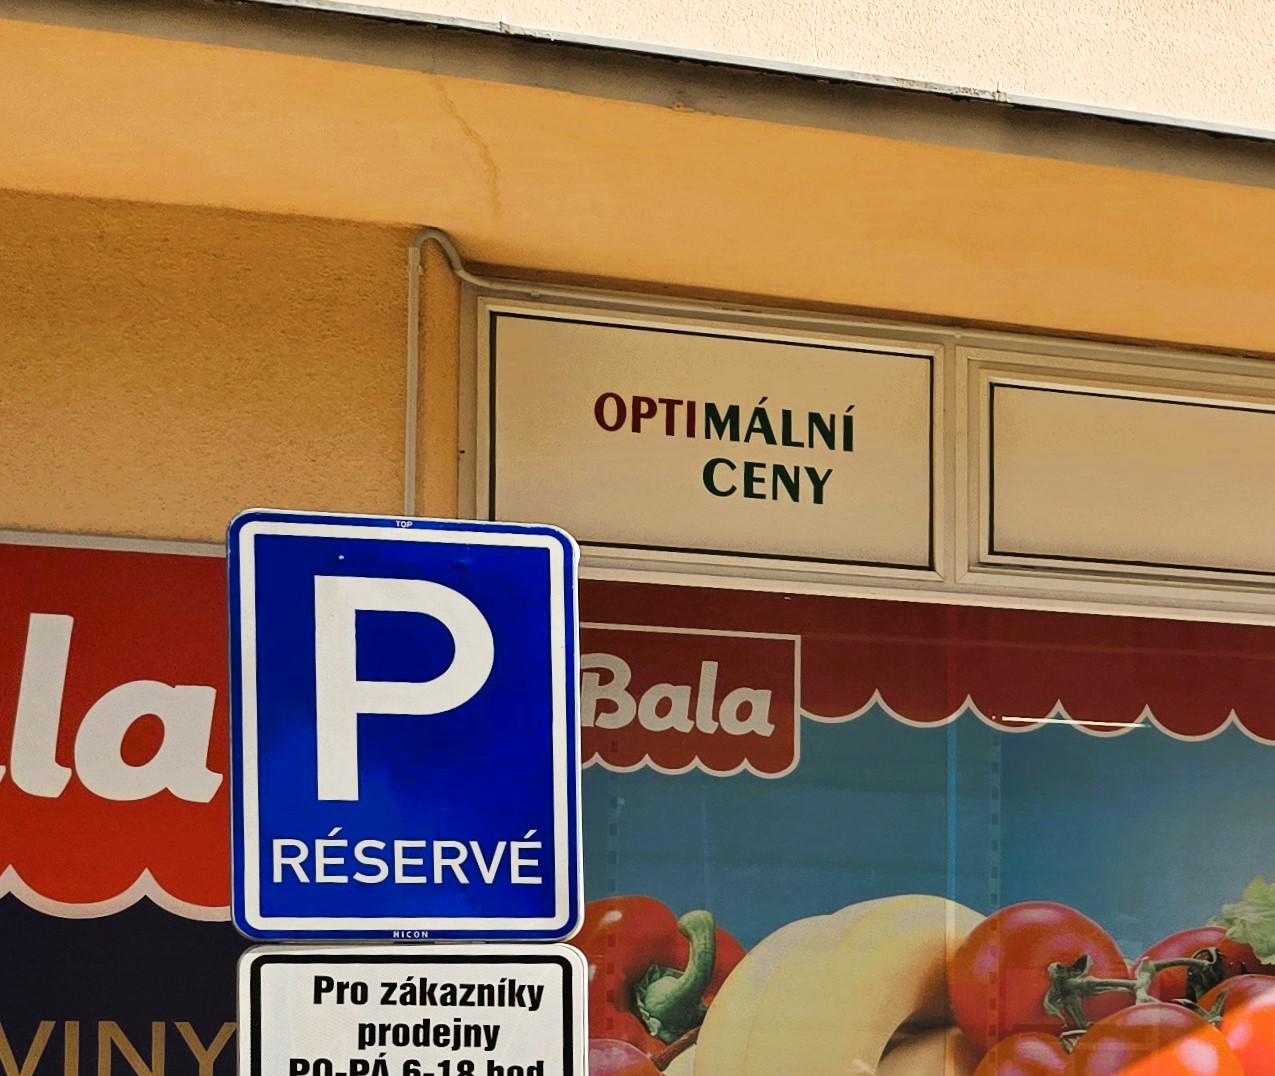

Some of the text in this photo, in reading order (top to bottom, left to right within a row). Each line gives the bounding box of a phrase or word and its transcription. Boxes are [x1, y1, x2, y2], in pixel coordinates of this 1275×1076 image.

[593, 391, 856, 452] OPTIMÁLNÍ
[702, 457, 834, 505] CENY
[396, 520, 413, 528] TOP
[0, 612, 224, 803] la
[315, 575, 494, 801] P
[581, 653, 775, 737] Bala
[272, 827, 542, 884] RÉSERVÉ
[393, 930, 428, 938] HICON
[313, 975, 544, 1011] Pro zákazníky
[357, 1018, 501, 1051] prodejny
